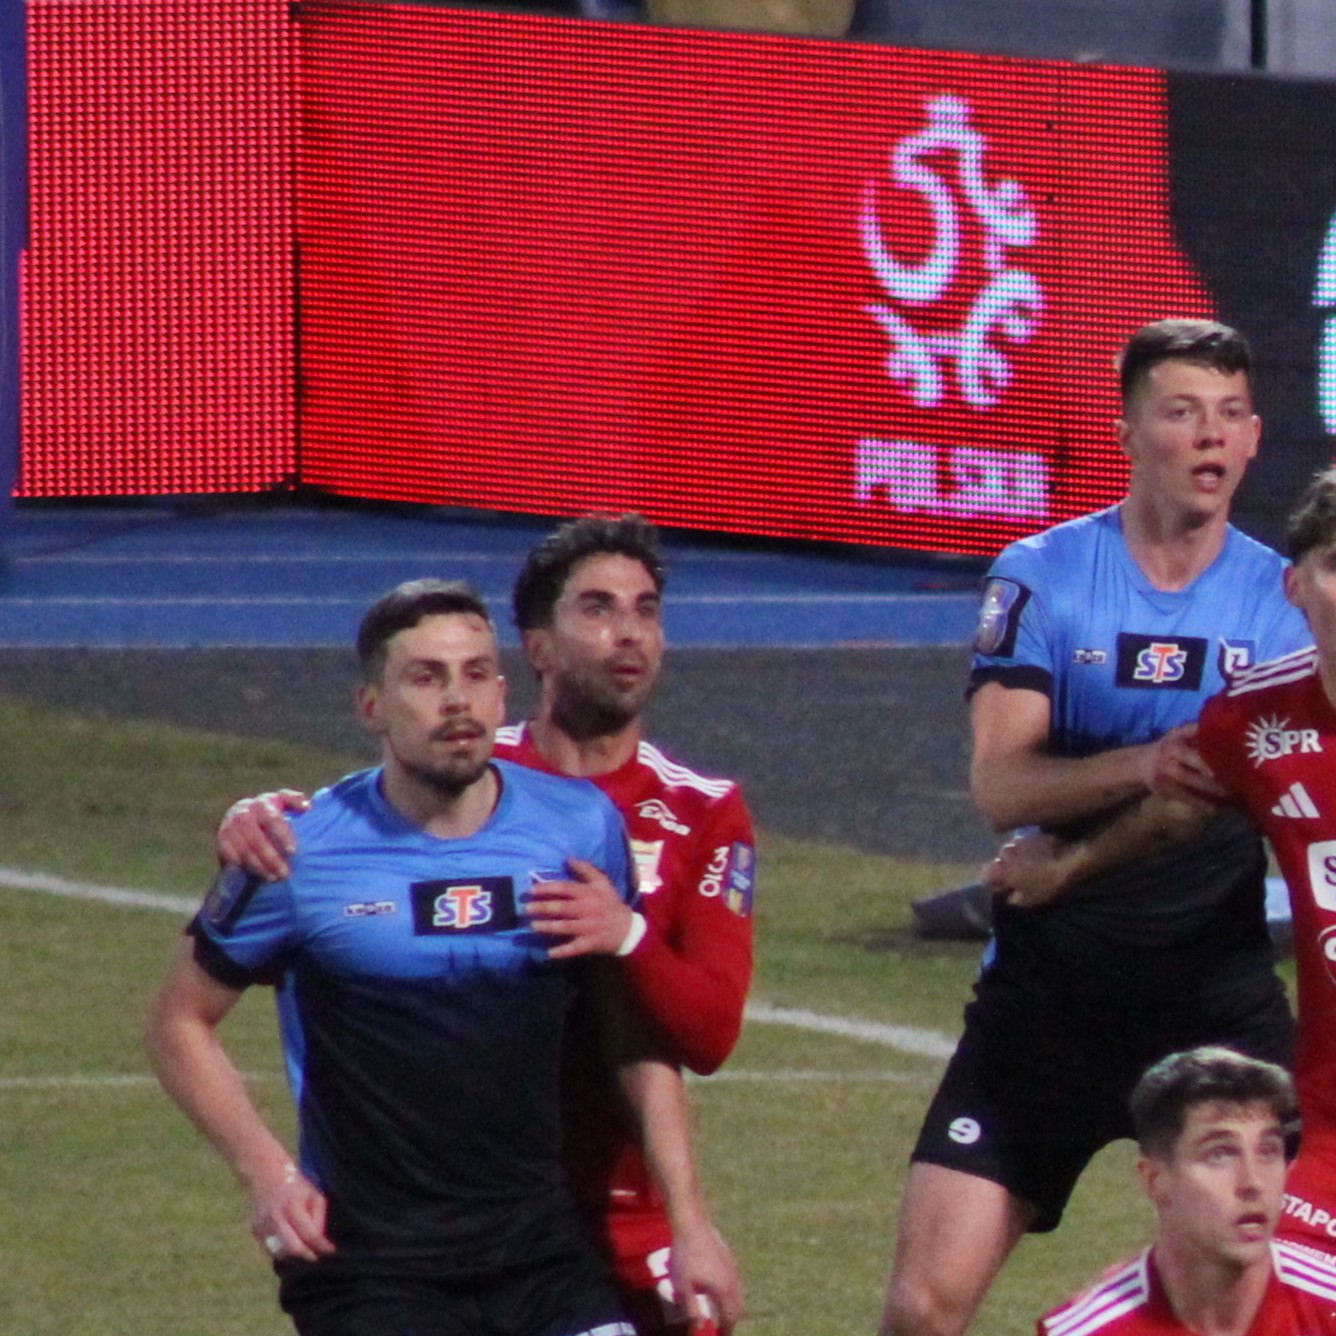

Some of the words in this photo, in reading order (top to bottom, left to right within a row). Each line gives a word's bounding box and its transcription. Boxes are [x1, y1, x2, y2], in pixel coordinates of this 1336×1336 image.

[1133, 643, 1187, 683] STS
[1262, 728, 1323, 759] SPR
[433, 885, 492, 927] STS
